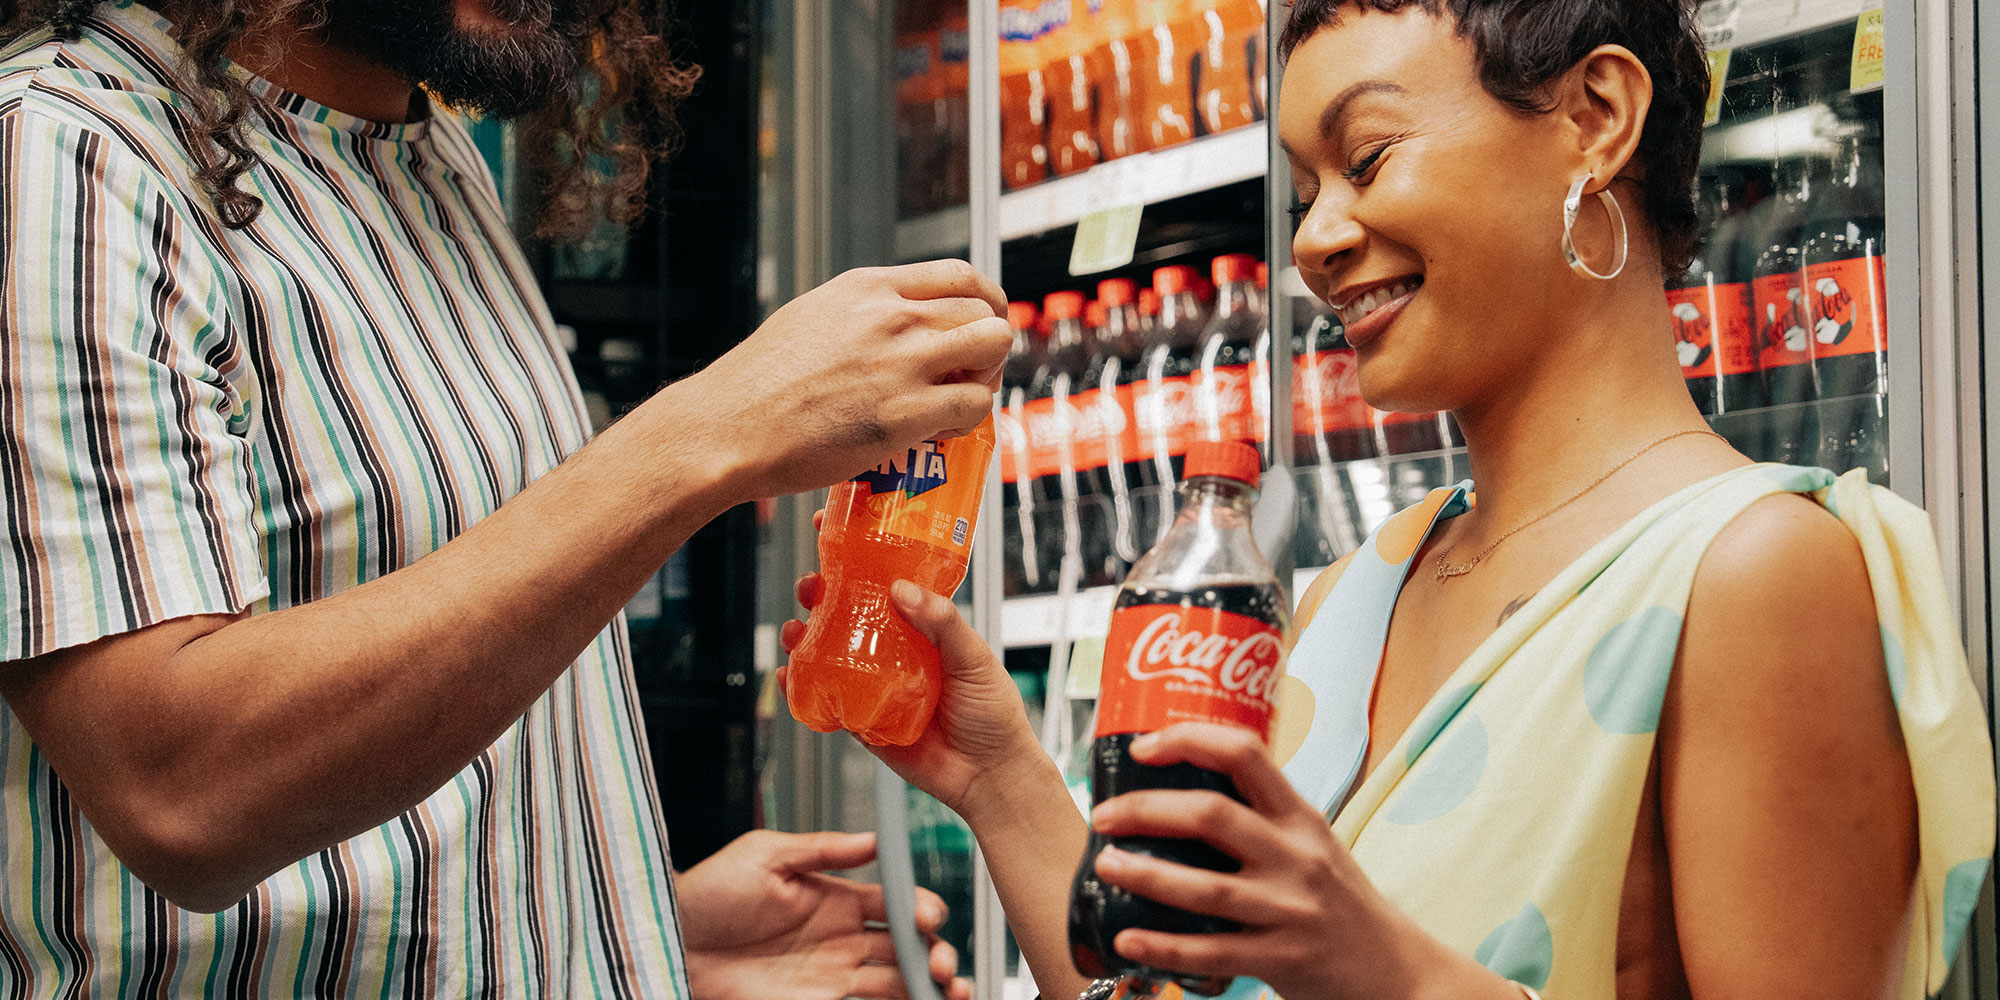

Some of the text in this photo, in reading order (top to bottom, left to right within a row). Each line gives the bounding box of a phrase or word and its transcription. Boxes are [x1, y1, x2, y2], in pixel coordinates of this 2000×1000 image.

[1858, 44, 1884, 64] FRE
[955, 519, 968, 534] 270
[1164, 680, 1231, 701] ORIGINAL
